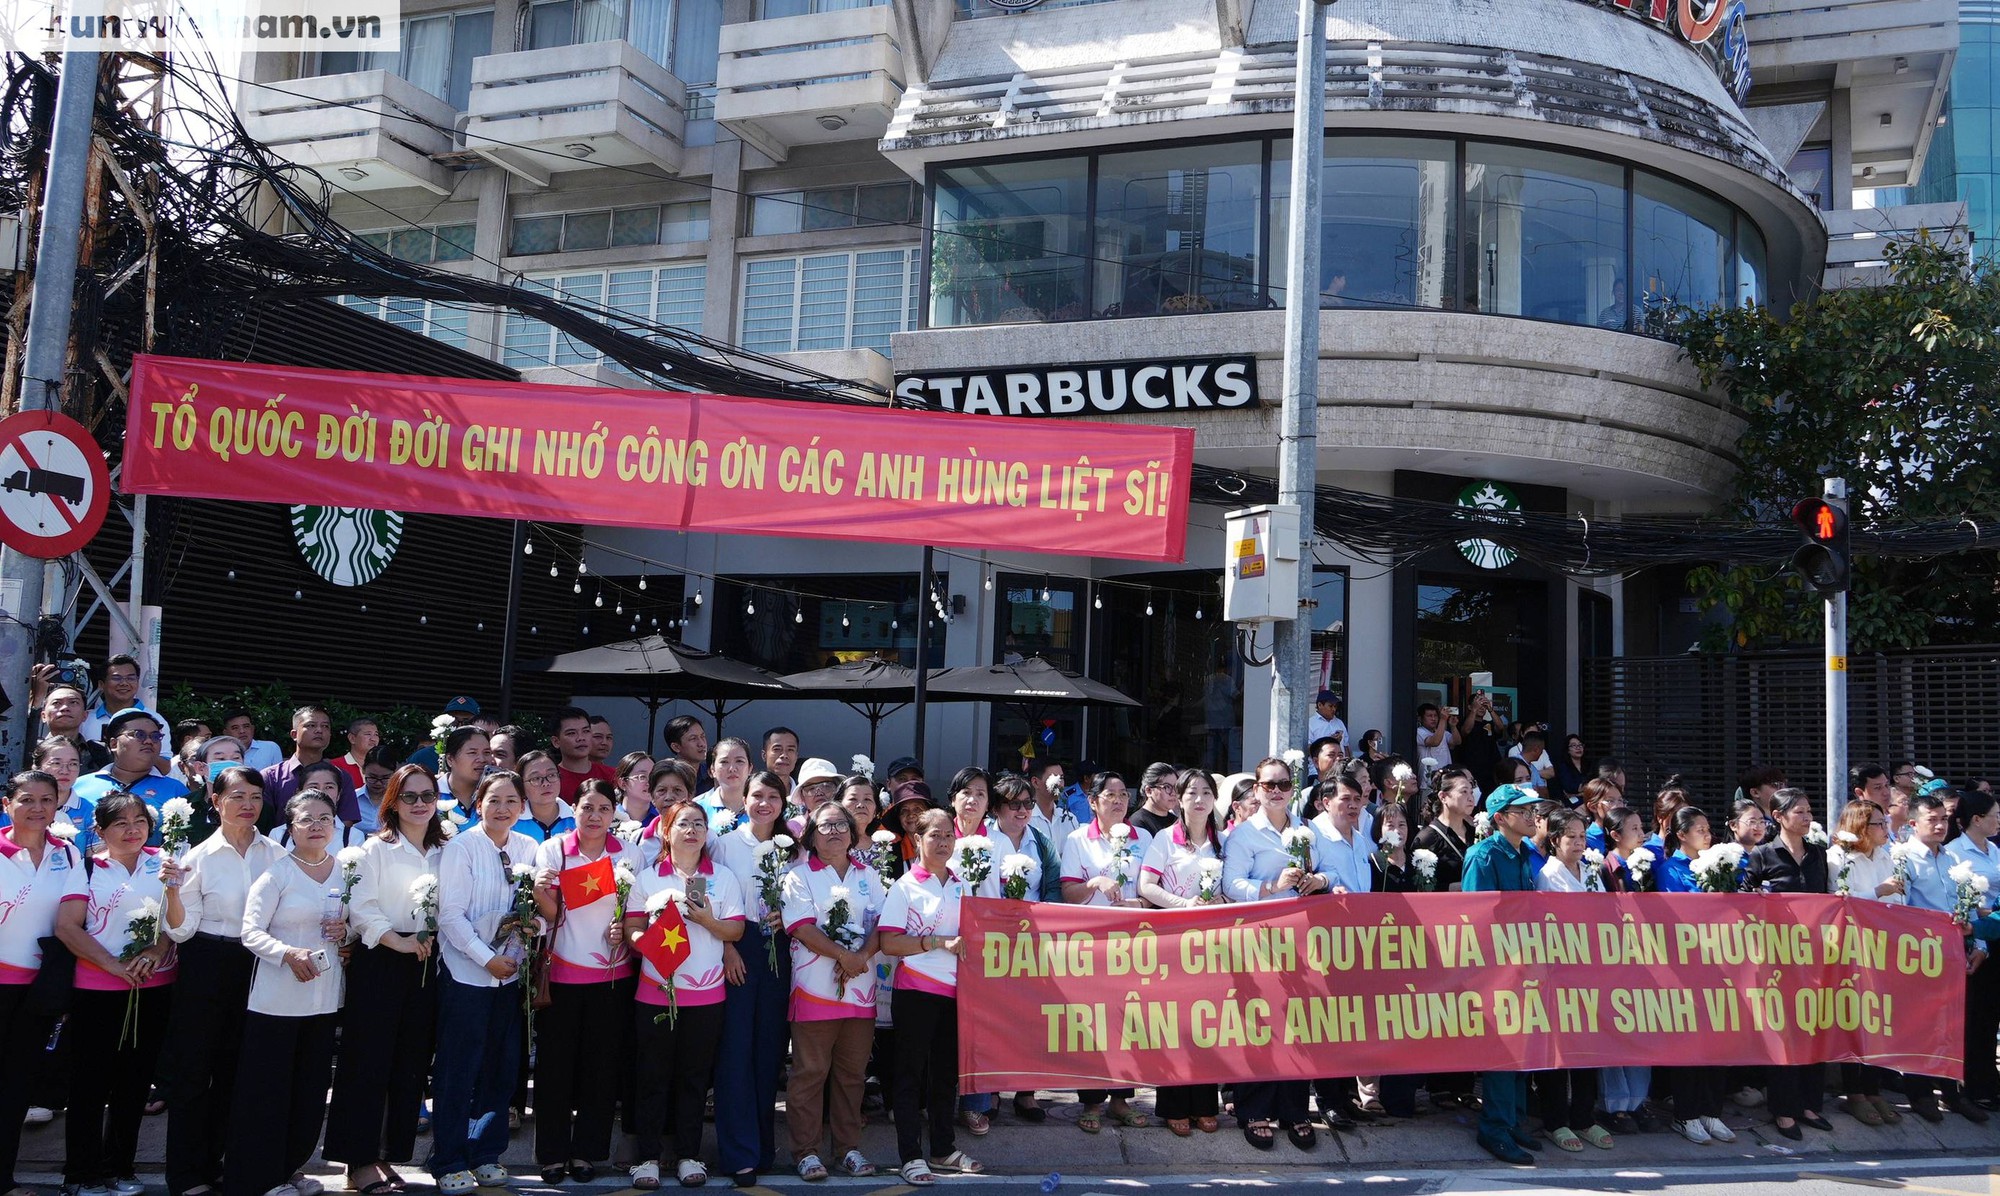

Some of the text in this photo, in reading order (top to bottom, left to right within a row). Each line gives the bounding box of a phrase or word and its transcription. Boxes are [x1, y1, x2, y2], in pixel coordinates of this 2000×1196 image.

[896, 363, 1252, 416] STARBUCKS
[151, 383, 1170, 522] TỔ QUỐC ĐỜI ĐỜI GHI NHỚ CÔNG ƠN CÁC ANH HÙNG LIỆT SĨ!
[1837, 658, 1844, 669] 5
[982, 912, 1944, 985] ĐẢNG BỘ, CHÍNH QUYỀN VÀ NHÂN DÂN PHƯỜNG BÀN CỜ
[1041, 969, 1893, 1053] TRI ÂN CÁC ANH HÙNG ĐÃ HY SINH VÌ TỔ QUỐC!
